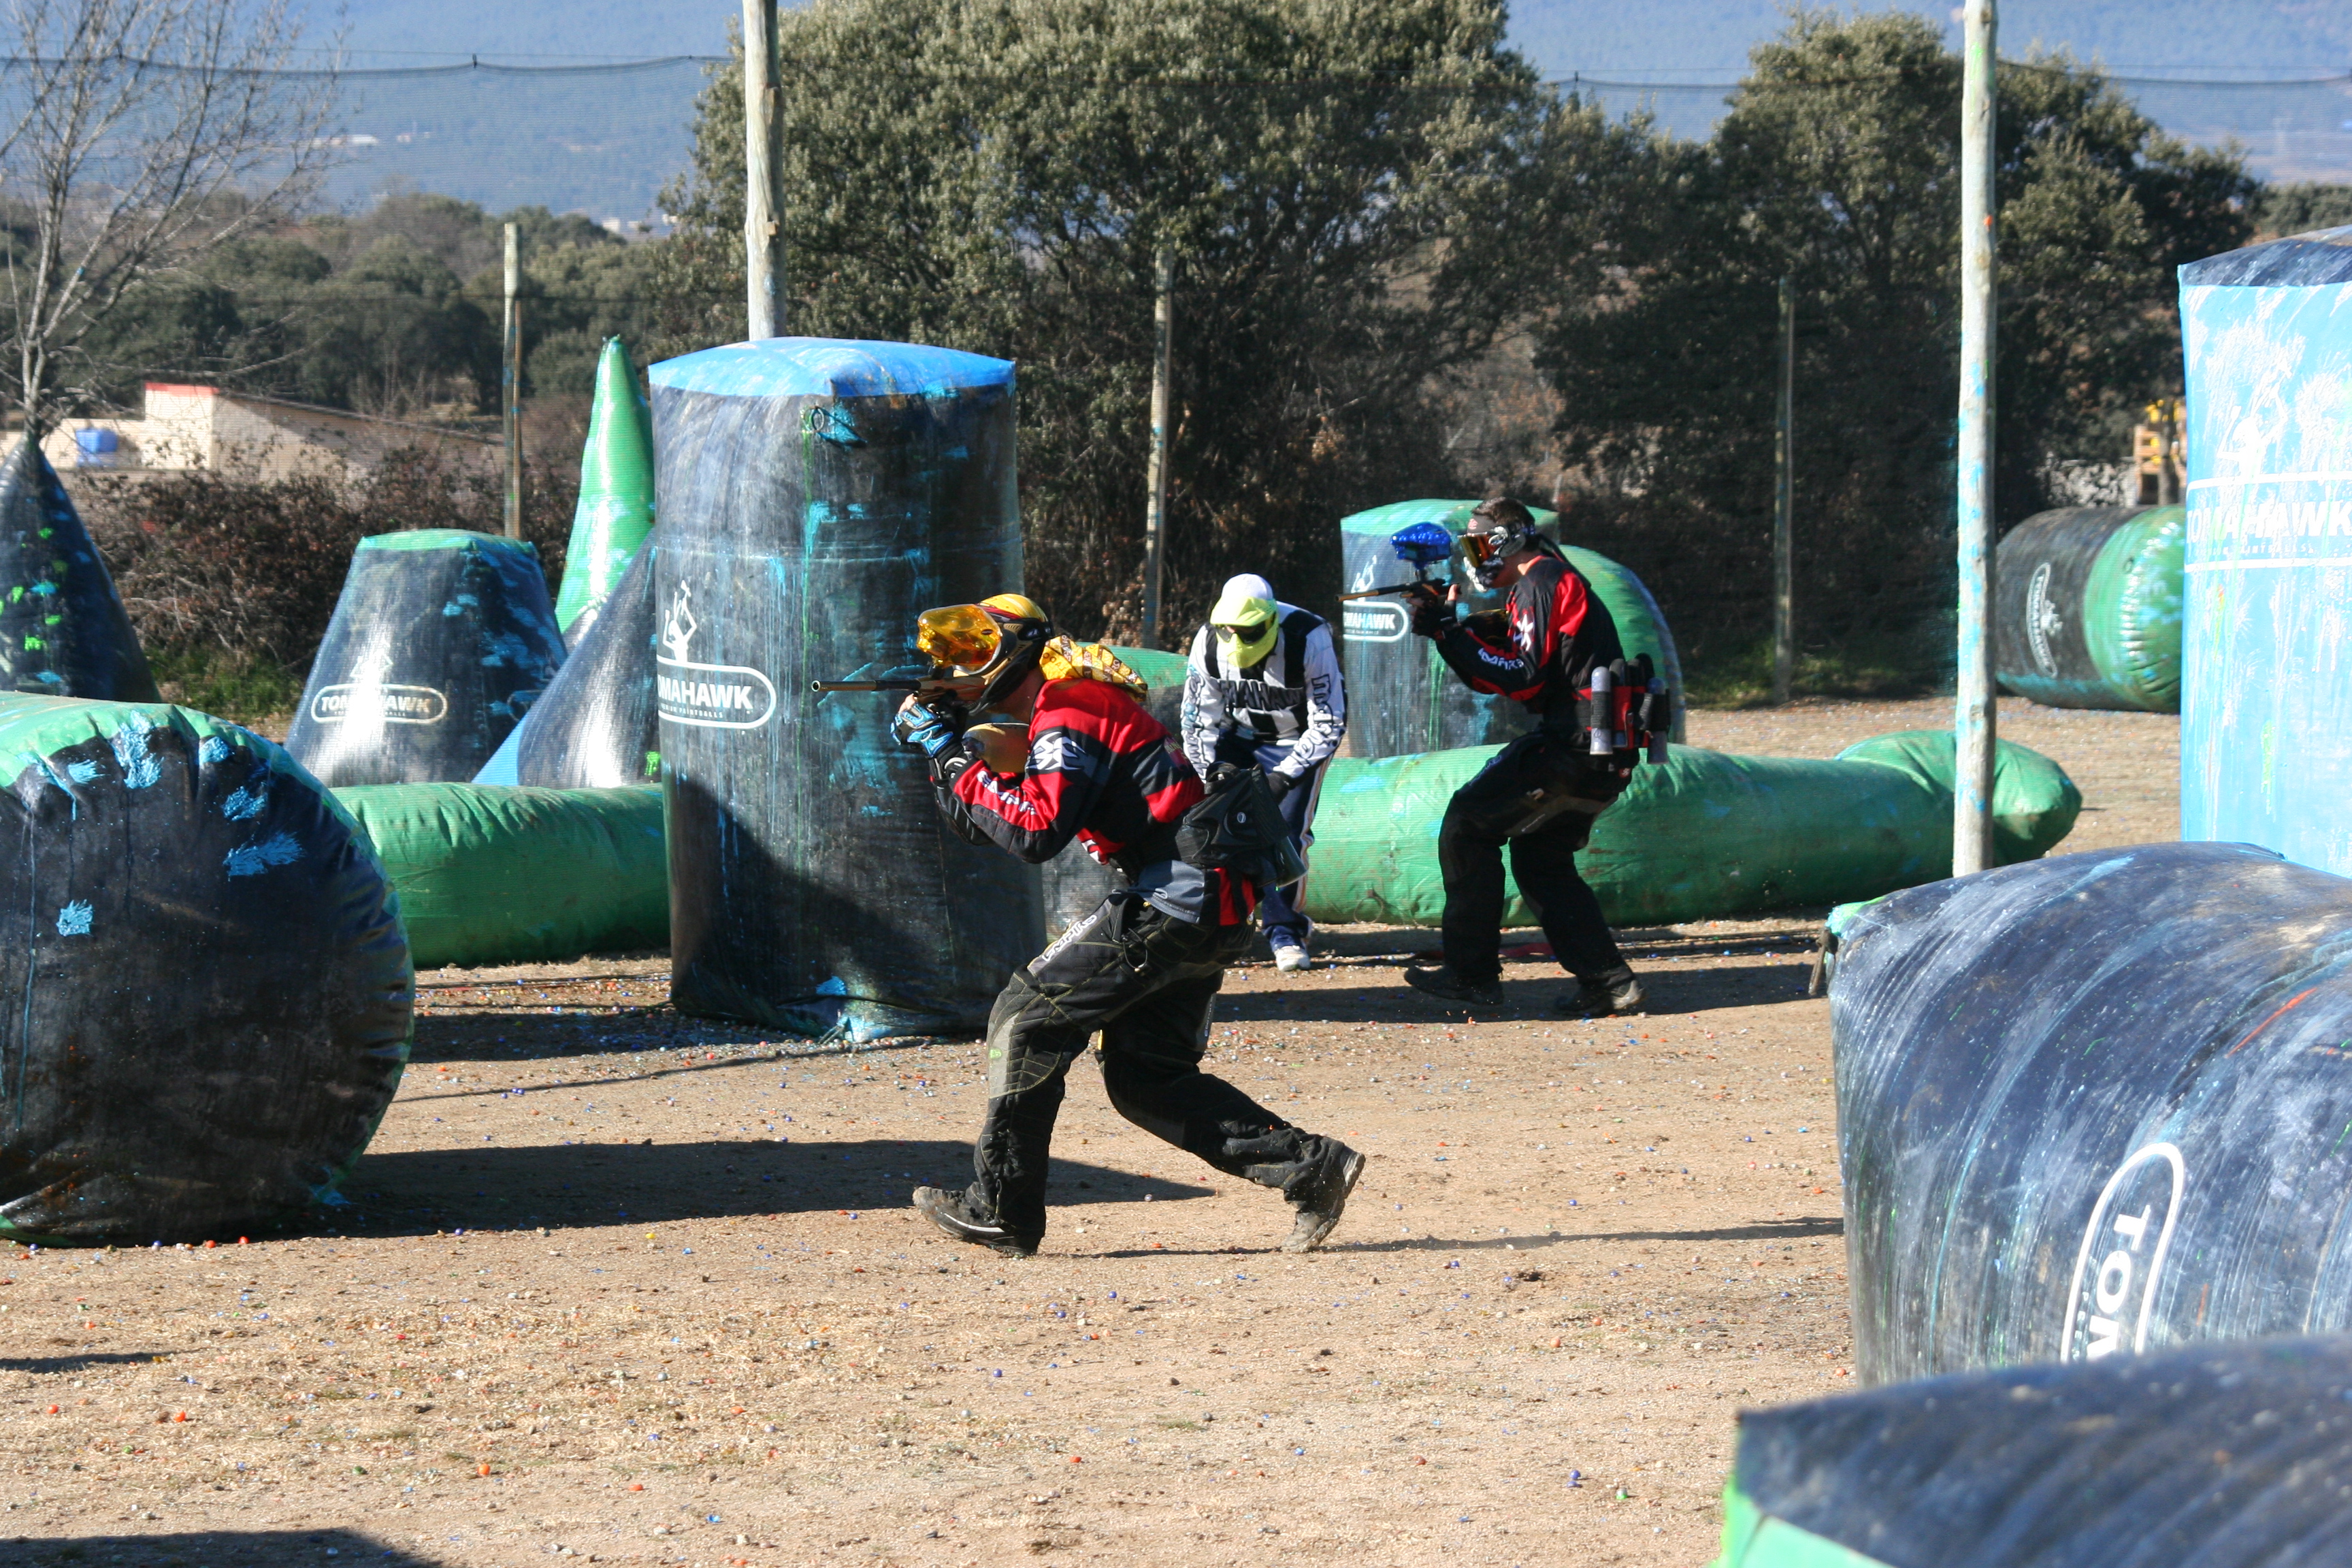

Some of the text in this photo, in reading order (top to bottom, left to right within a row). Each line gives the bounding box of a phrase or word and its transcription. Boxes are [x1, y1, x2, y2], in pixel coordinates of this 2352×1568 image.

[1343, 611, 1396, 630] AHAWK
[657, 674, 754, 710] OMAHAWK
[321, 694, 431, 713] TOAWK
